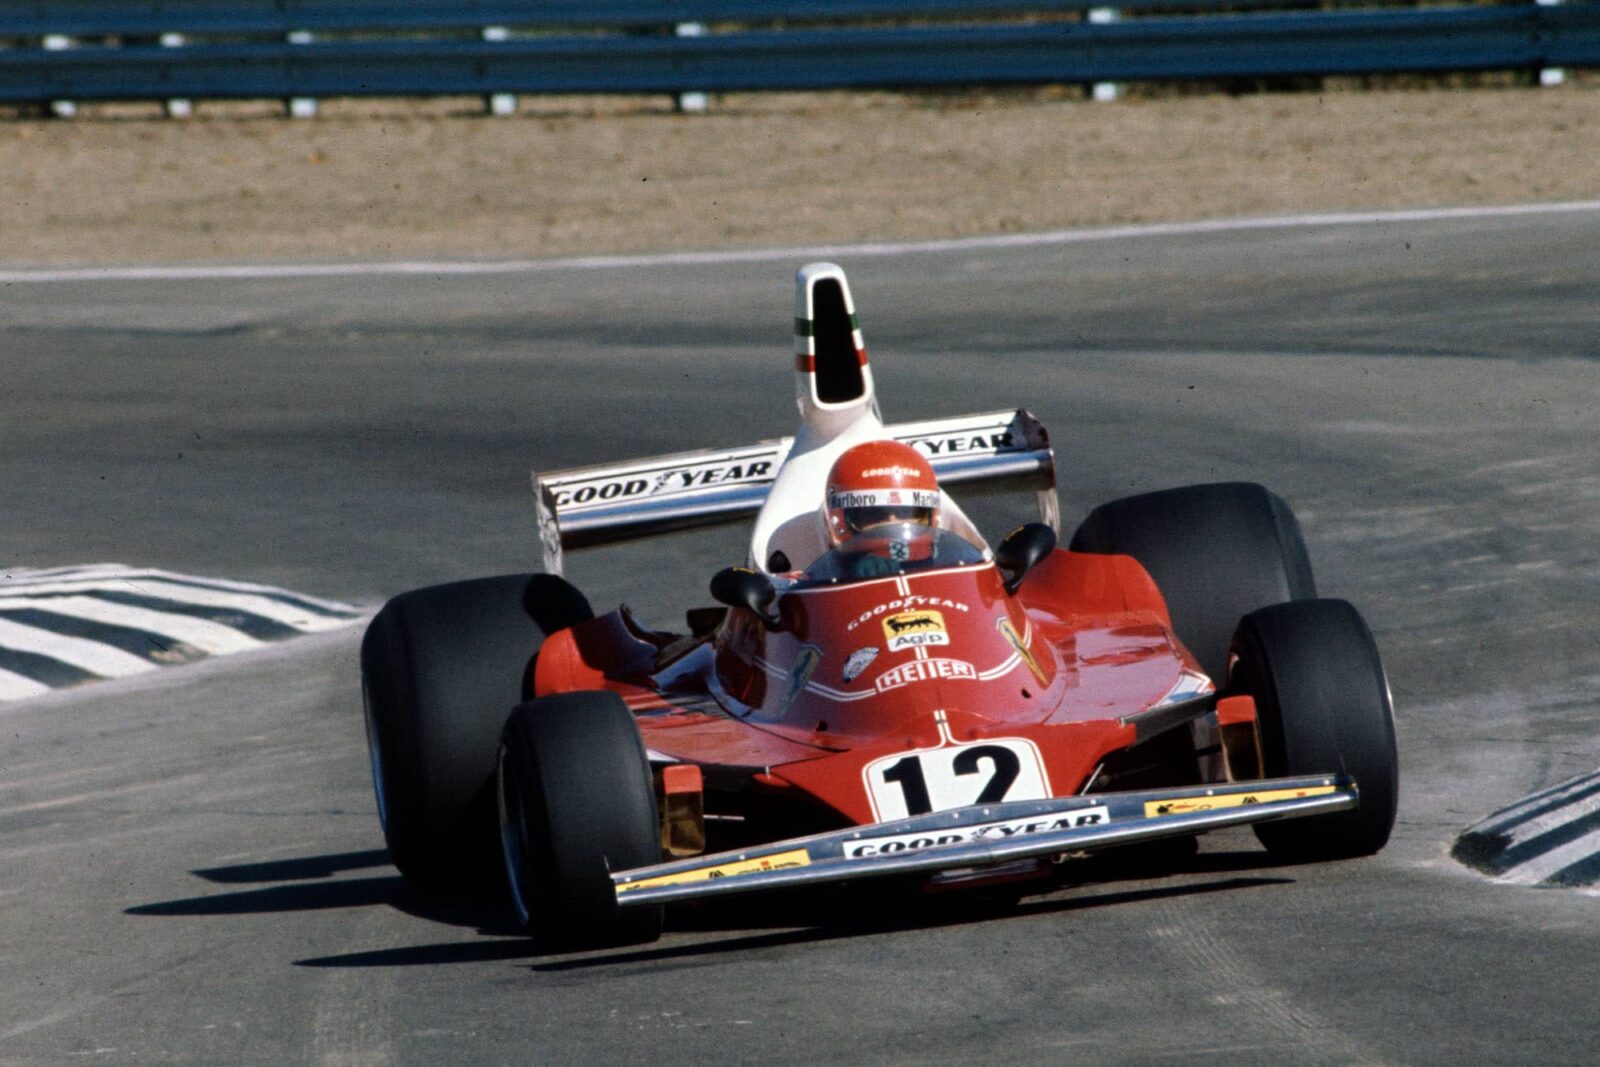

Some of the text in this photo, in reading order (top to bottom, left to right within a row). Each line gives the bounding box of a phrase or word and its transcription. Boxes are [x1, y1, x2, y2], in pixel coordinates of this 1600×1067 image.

[924, 432, 1014, 454] YEAR
[554, 460, 772, 505] GOOD YEAR
[895, 632, 943, 648] Agip
[882, 744, 1021, 817] 12
[851, 813, 1102, 858] GOOD YEAR
